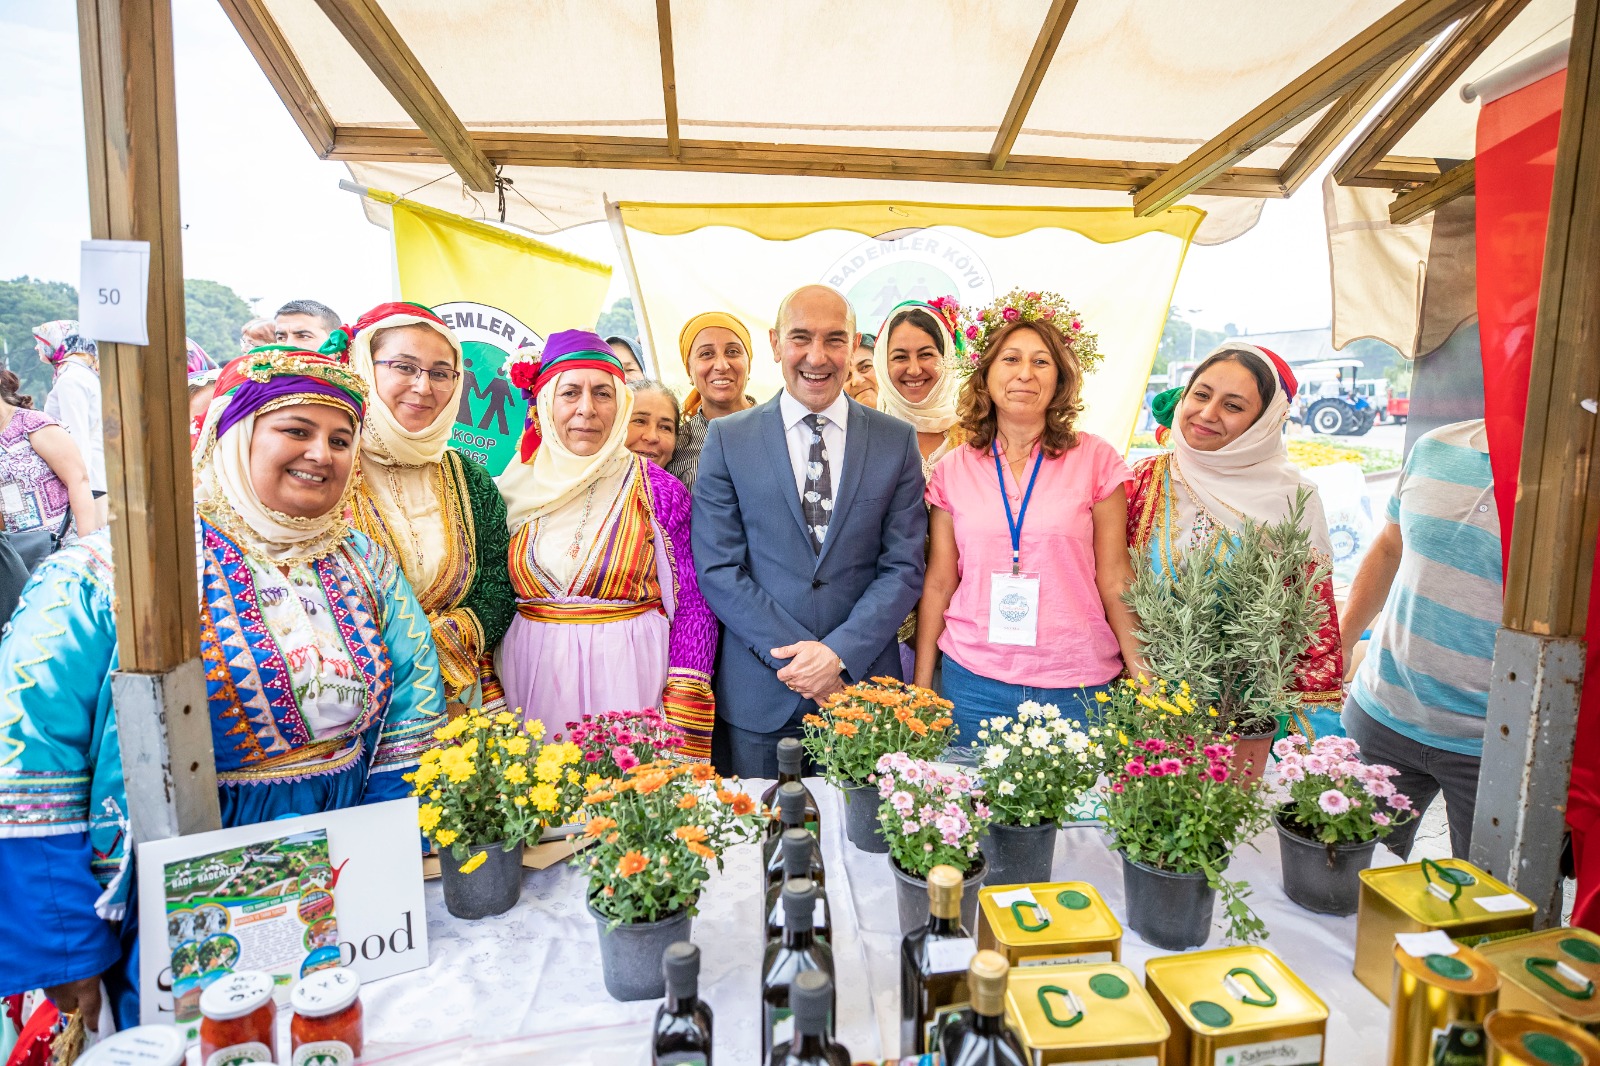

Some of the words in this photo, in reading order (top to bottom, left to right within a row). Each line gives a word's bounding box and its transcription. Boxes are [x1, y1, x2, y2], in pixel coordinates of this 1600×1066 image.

[829, 237, 940, 288] BADEMLER
[942, 246, 985, 290] KÖYÜ
[98, 288, 121, 305] 50
[441, 311, 516, 342] EMLER
[453, 428, 496, 450] KOOP
[339, 910, 416, 968] ood
